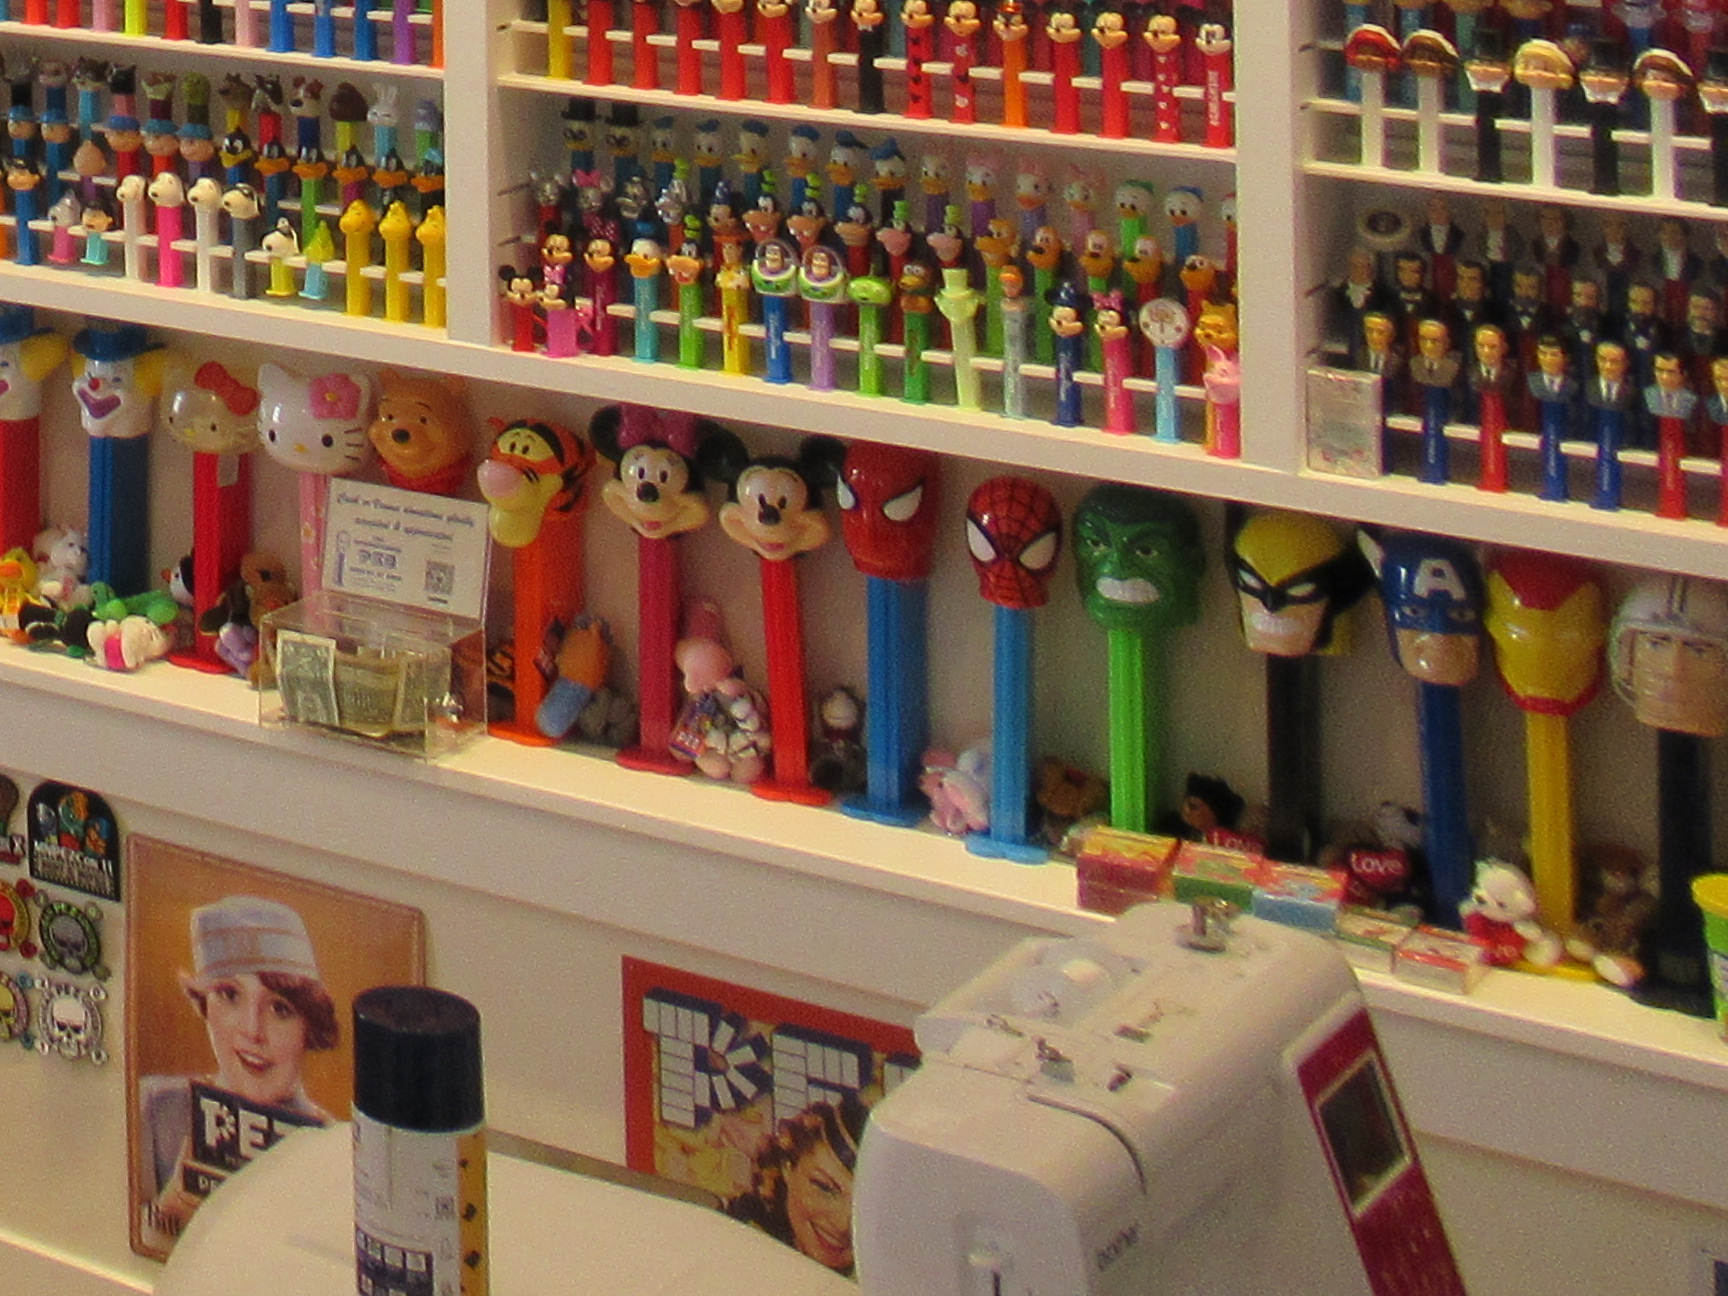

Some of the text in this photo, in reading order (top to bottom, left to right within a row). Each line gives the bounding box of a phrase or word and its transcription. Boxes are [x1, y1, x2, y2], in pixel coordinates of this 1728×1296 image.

[1350, 853, 1403, 875] Love
[642, 996, 919, 1130] PE
[199, 1096, 296, 1160] PE
